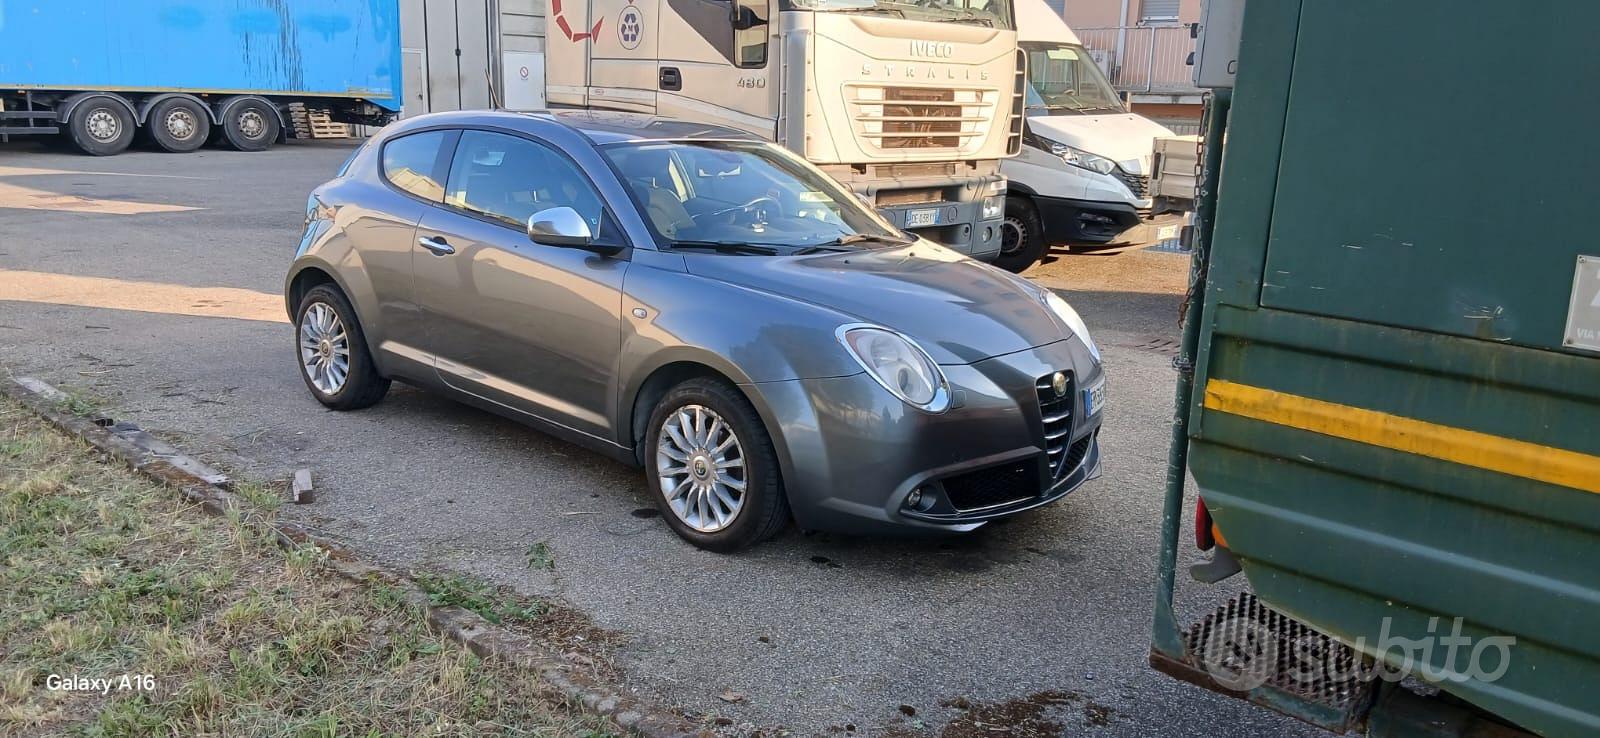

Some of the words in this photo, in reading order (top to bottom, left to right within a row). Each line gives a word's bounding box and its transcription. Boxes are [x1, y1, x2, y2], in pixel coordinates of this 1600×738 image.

[909, 39, 954, 58] IVECO
[861, 62, 989, 81] STRALIS
[736, 76, 767, 89] 480
